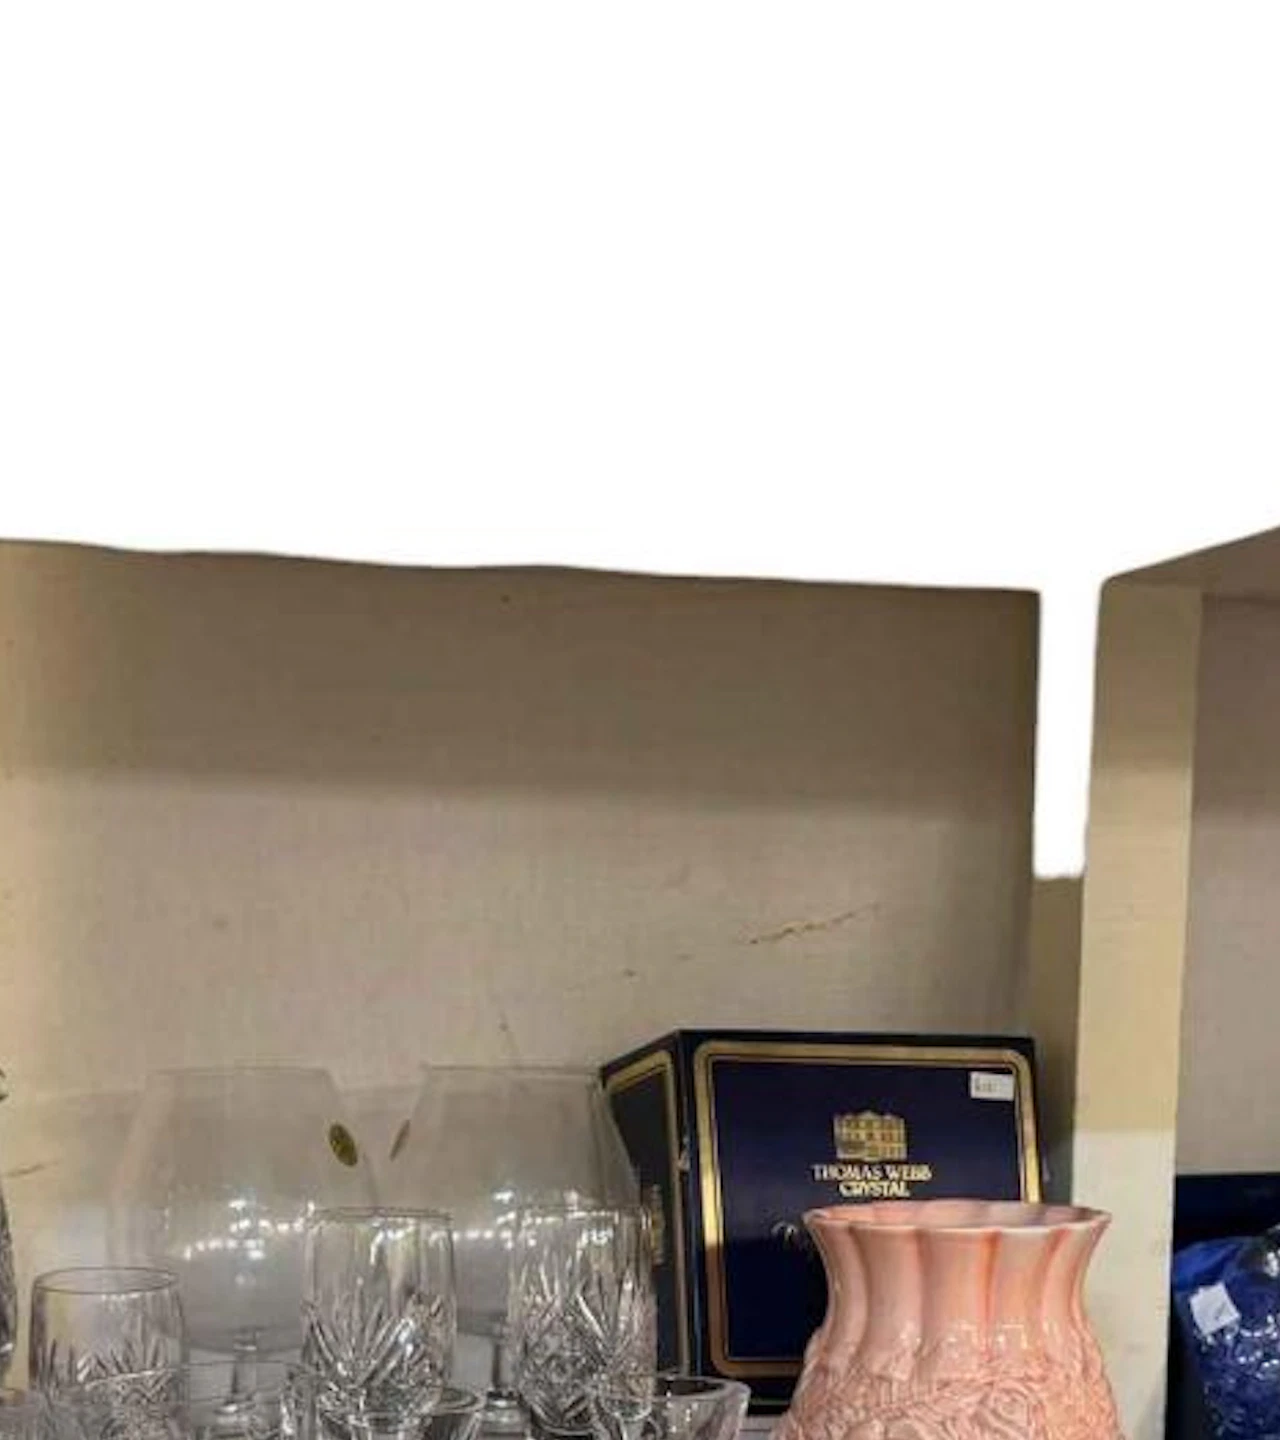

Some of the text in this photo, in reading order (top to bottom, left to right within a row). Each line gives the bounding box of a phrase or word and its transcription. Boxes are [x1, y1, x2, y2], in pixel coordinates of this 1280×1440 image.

[811, 1164, 933, 1181] THOMAS WEBB
[839, 1181, 910, 1197] CRYSTAL
